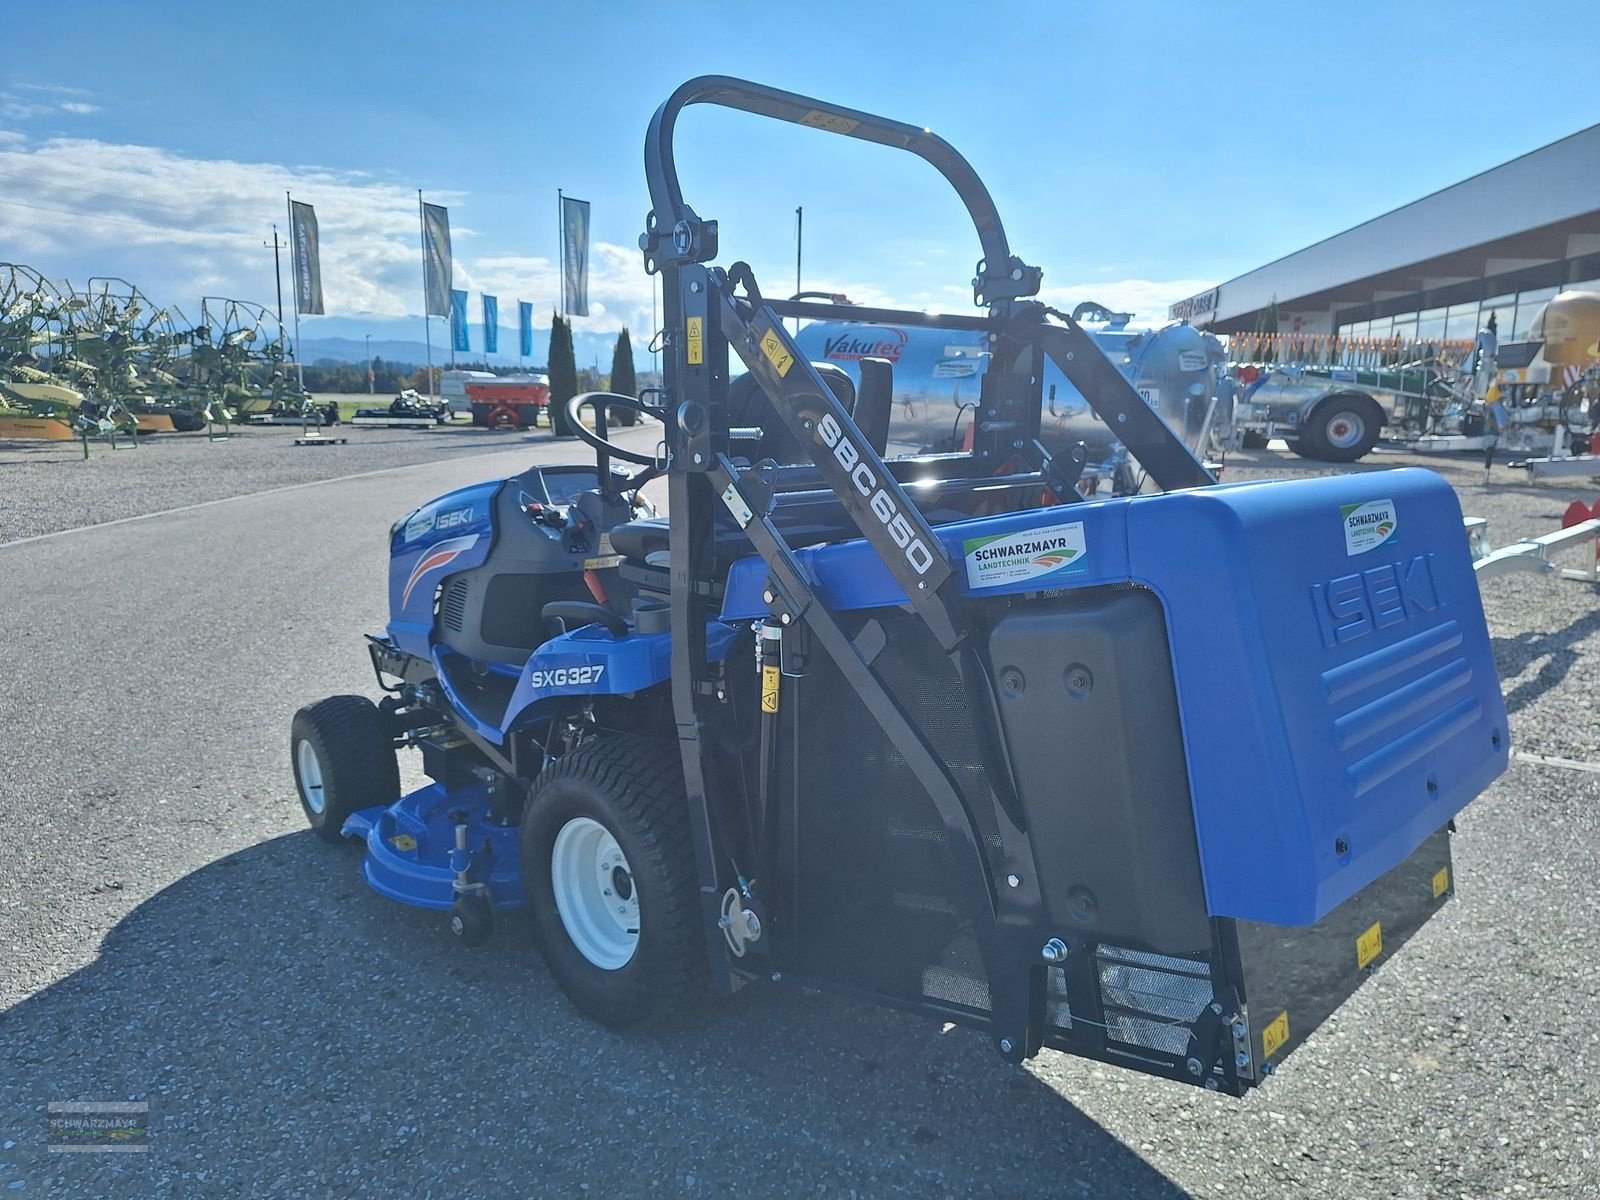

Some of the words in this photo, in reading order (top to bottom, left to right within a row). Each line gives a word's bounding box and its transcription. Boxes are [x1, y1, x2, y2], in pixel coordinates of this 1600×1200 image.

[824, 333, 904, 358] Vakutec
[817, 413, 934, 575] SBC650
[435, 508, 474, 530] ISEKI
[1349, 511, 1389, 527] SCHWARZMAYR
[975, 537, 1067, 561] SCHWARZMAYR
[978, 557, 1031, 571] LANDTECHNIK
[1309, 552, 1446, 648] ISEKI
[531, 665, 605, 688] SXG327
